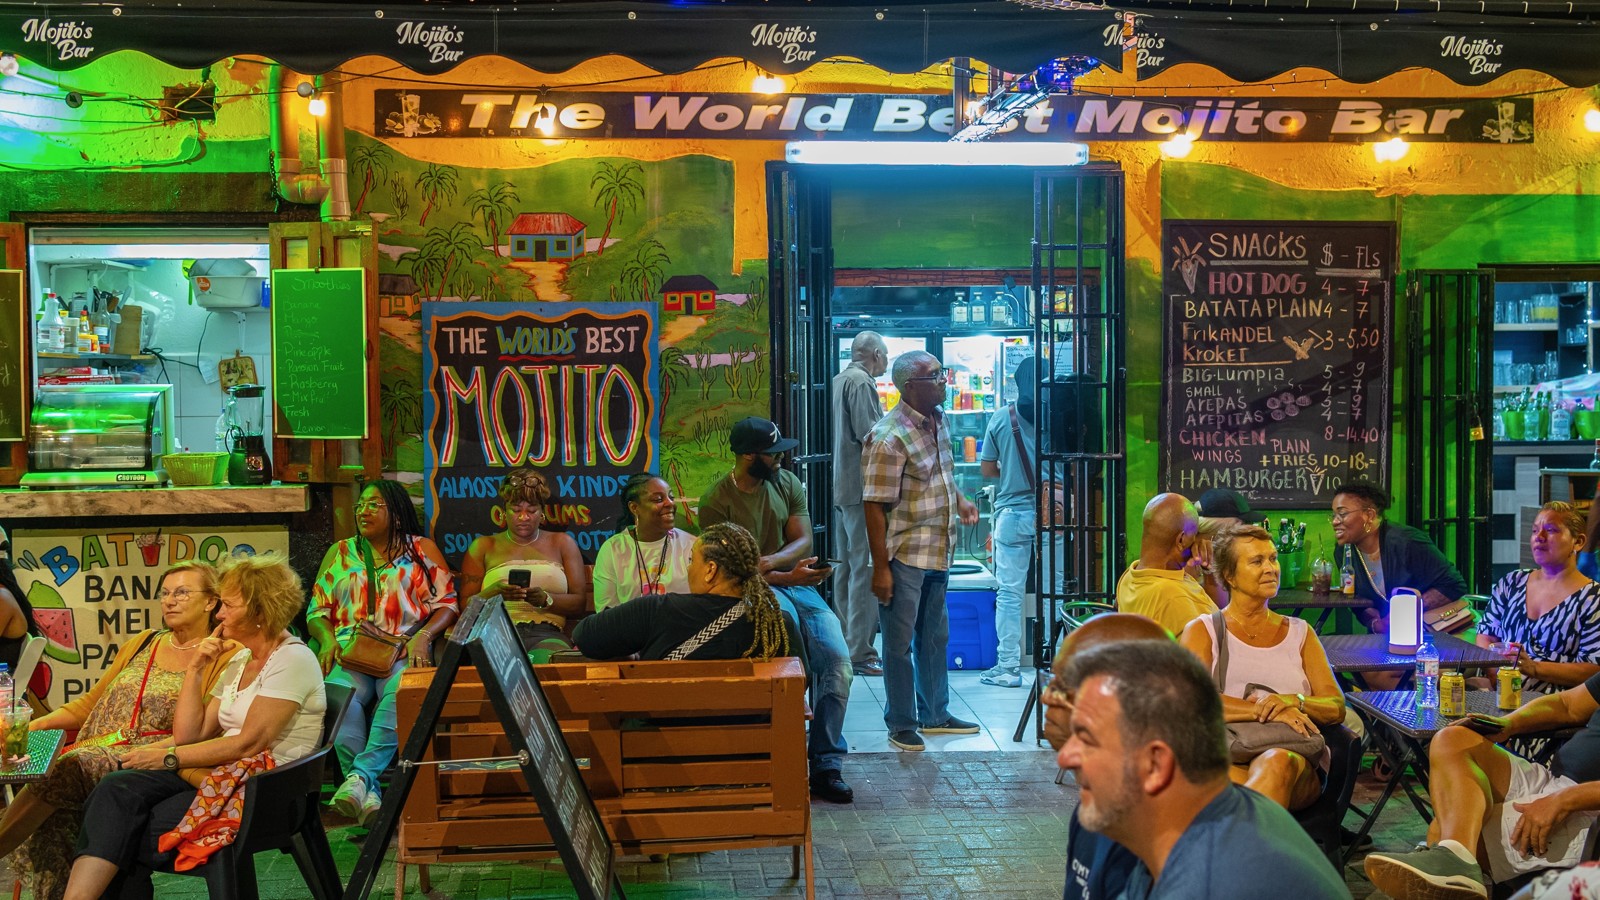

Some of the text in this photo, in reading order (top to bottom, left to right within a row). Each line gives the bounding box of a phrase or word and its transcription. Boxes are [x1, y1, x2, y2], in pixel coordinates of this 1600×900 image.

[21, 18, 93, 43] Mojito's
[396, 21, 464, 45] Mojito's
[751, 23, 817, 46] Mojito's
[57, 40, 94, 60] Bar
[429, 43, 464, 64] Bar
[782, 42, 816, 64] Bar
[1440, 35, 1503, 57] Mojito's
[1136, 48, 1165, 68] Bar
[1469, 54, 1502, 75] Bar
[461, 94, 1466, 137] The World Bet Mojito Bar
[1208, 231, 1307, 259] SNACKS
[1321, 242, 1333, 266] $
[1208, 271, 1256, 295] HOT
[1261, 272, 1307, 295] DOG
[1321, 278, 1331, 296] 4
[1358, 280, 1369, 295] 7
[1184, 299, 1262, 318] BATATA
[1267, 299, 1323, 318] PLAIN
[1323, 302, 1333, 319] 4
[1357, 301, 1369, 319] 7
[442, 322, 639, 354] THE WORLD'S BEST
[1323, 330, 1334, 350] 3
[1322, 365, 1333, 380] 5
[1353, 362, 1365, 377] 9
[1185, 386, 1222, 398] SMALL
[1321, 382, 1332, 394] 4
[1352, 380, 1362, 394] 7
[439, 364, 645, 468] MOJITO
[1321, 409, 1332, 421] 4
[1352, 408, 1361, 421] 7
[1179, 429, 1266, 447] CHICKEN
[1324, 426, 1333, 440] 8
[1270, 439, 1310, 454] PLAIN
[1192, 450, 1242, 464] WINGS
[439, 476, 505, 498] ALMOST
[1181, 467, 1307, 491] HAMBURGER
[490, 504, 592, 528] O UMS
[82, 643, 119, 670] PA
